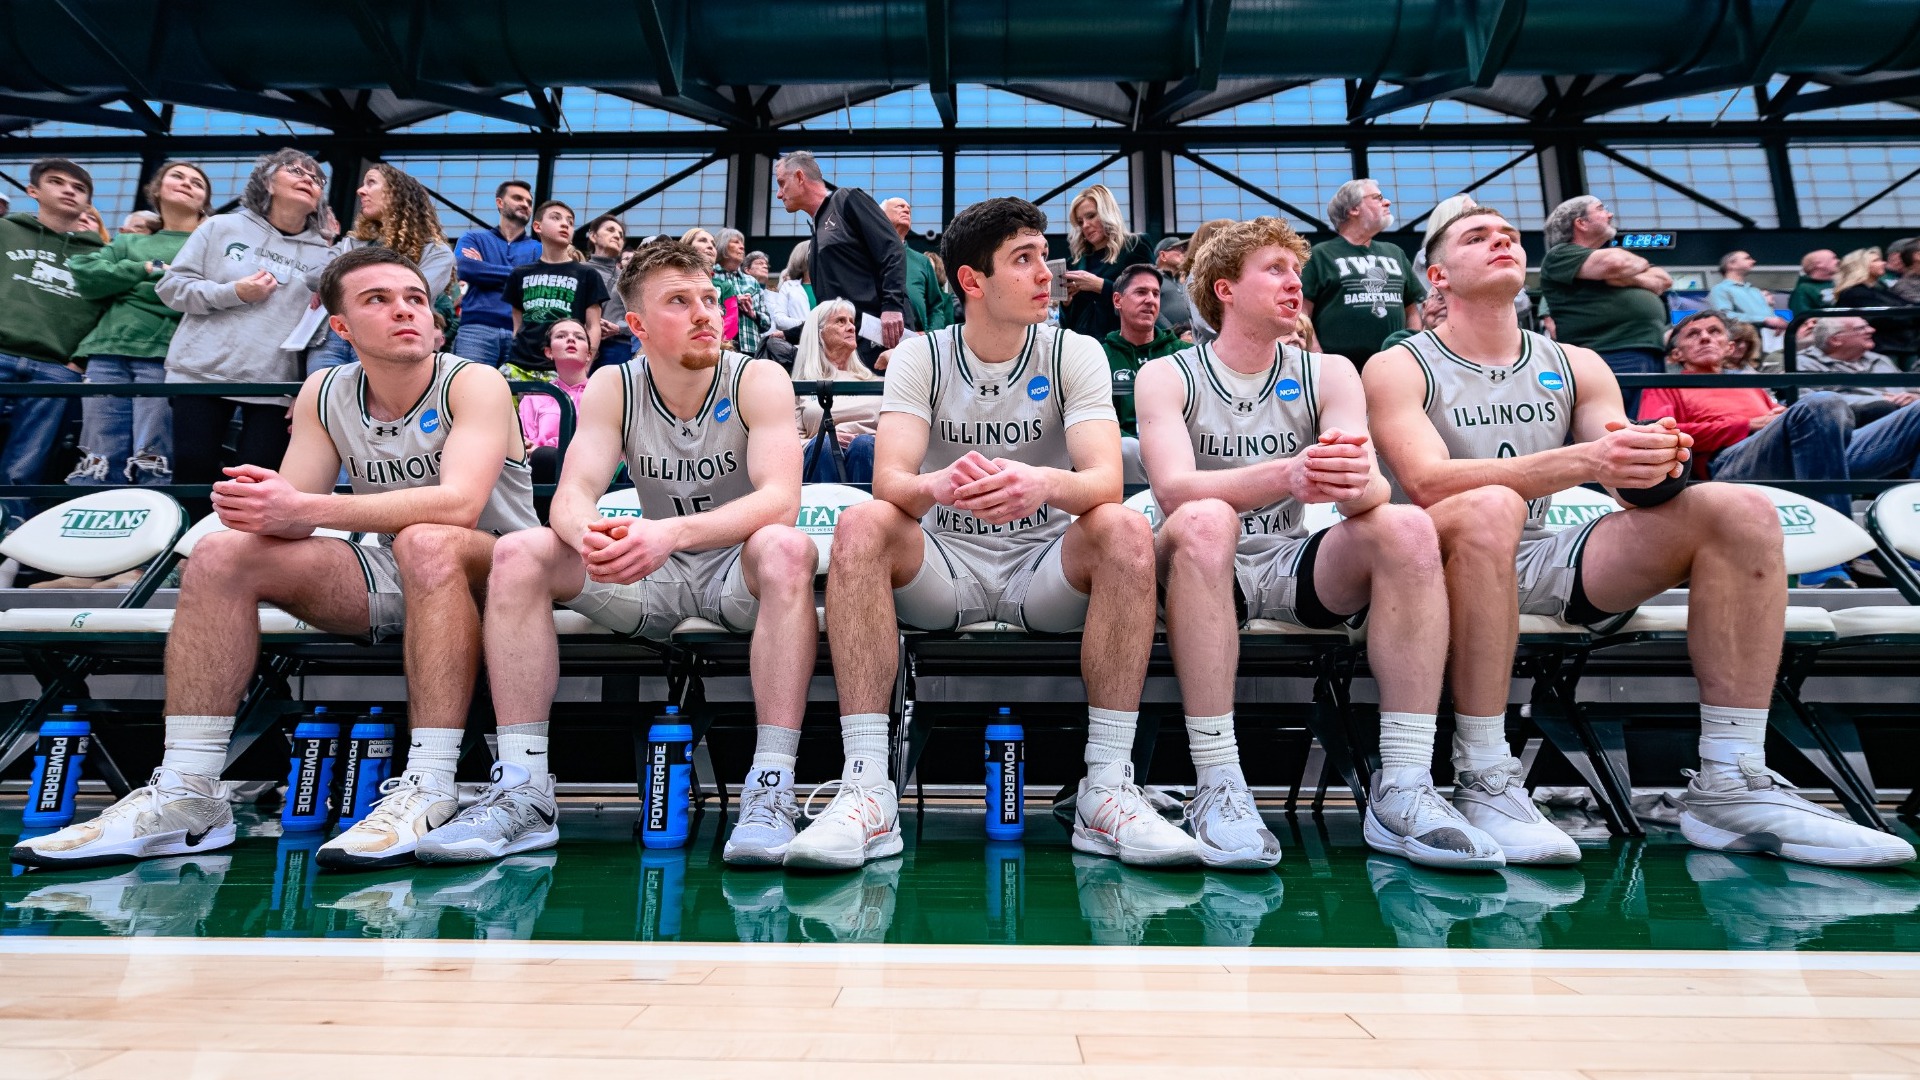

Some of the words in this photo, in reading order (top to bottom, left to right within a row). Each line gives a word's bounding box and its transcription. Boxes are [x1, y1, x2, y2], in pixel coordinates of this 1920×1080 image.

[1623, 233, 1671, 248] 6:28:24
[1335, 254, 1402, 276] IWU
[522, 273, 578, 291] EUREKA
[1344, 292, 1403, 305] BASKETBALL
[1031, 384, 1050, 396] NCAA
[1279, 387, 1300, 397] NCAA
[1453, 401, 1557, 428] ILLINOIS
[939, 417, 1043, 446] ILLINOIS
[1198, 432, 1299, 458] ILLINOIS
[638, 449, 738, 483] ILLINOIS
[62, 509, 149, 529] TITANS
[40, 737, 69, 810] POWERADE
[297, 739, 320, 814] POWERADE
[341, 740, 359, 815] POWERADE
[650, 744, 667, 829] POWERADE
[1004, 742, 1016, 821] POWERADE
